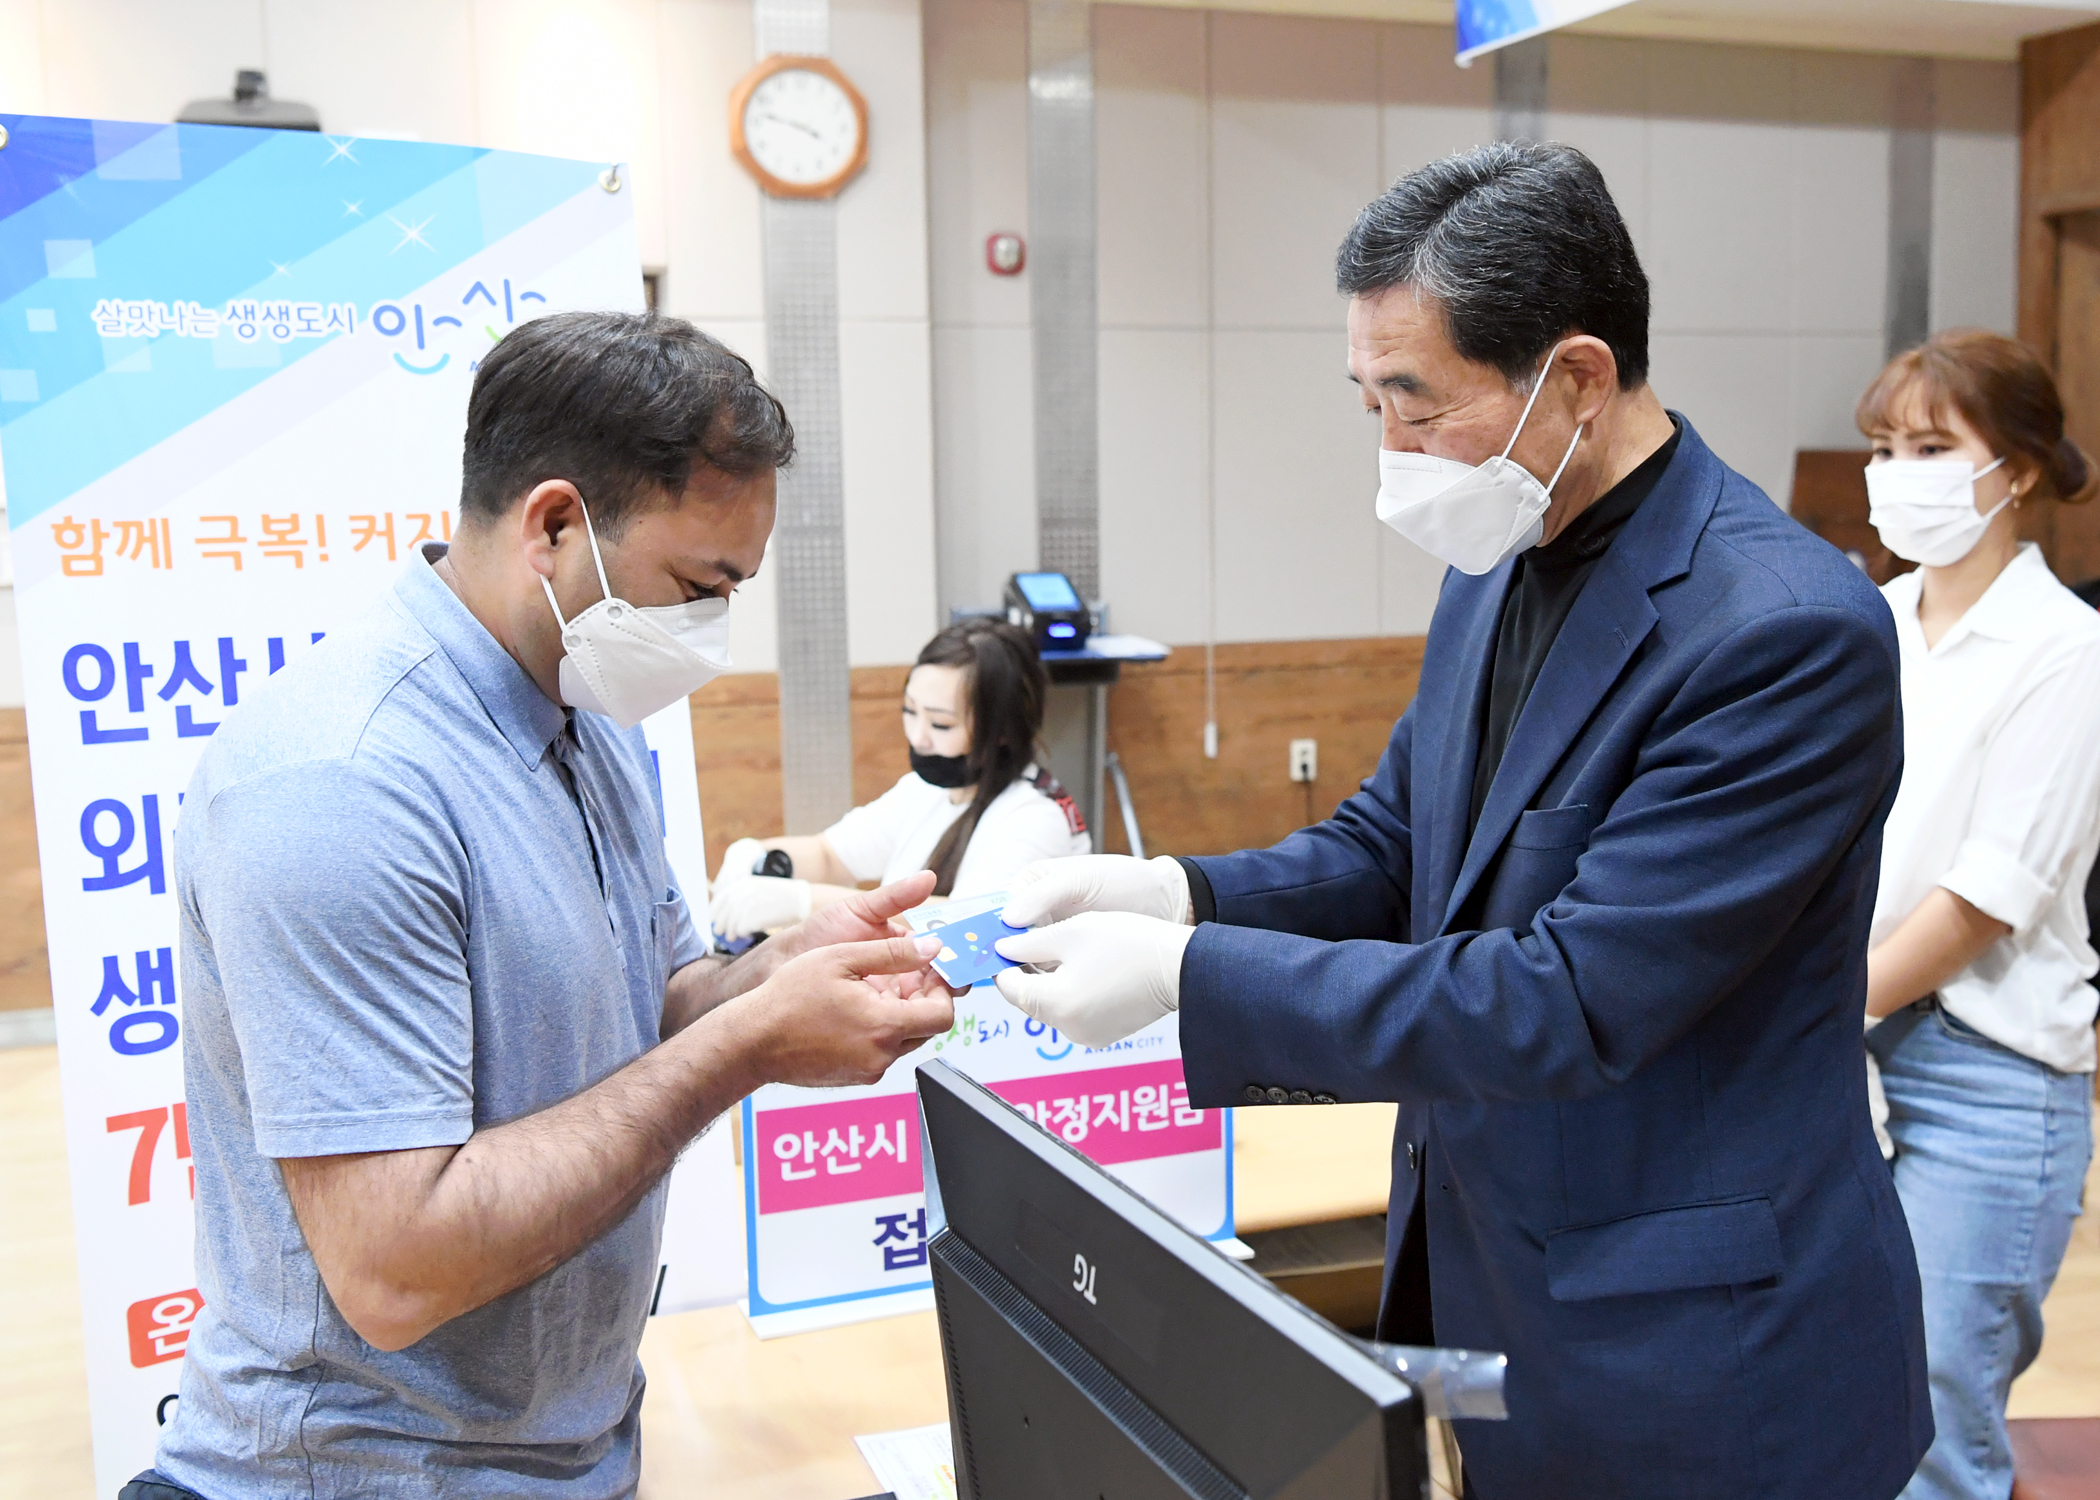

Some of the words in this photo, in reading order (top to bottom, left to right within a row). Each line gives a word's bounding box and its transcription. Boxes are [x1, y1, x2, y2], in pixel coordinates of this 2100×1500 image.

[95, 303, 217, 334] 살맛나는
[228, 303, 355, 339] 생생도시
[51, 514, 173, 577] 함께
[194, 513, 329, 572] 극복!
[1136, 1036, 1163, 1049] CITY
[773, 1119, 907, 1181] 안산시
[1073, 1253, 1097, 1305] TG
